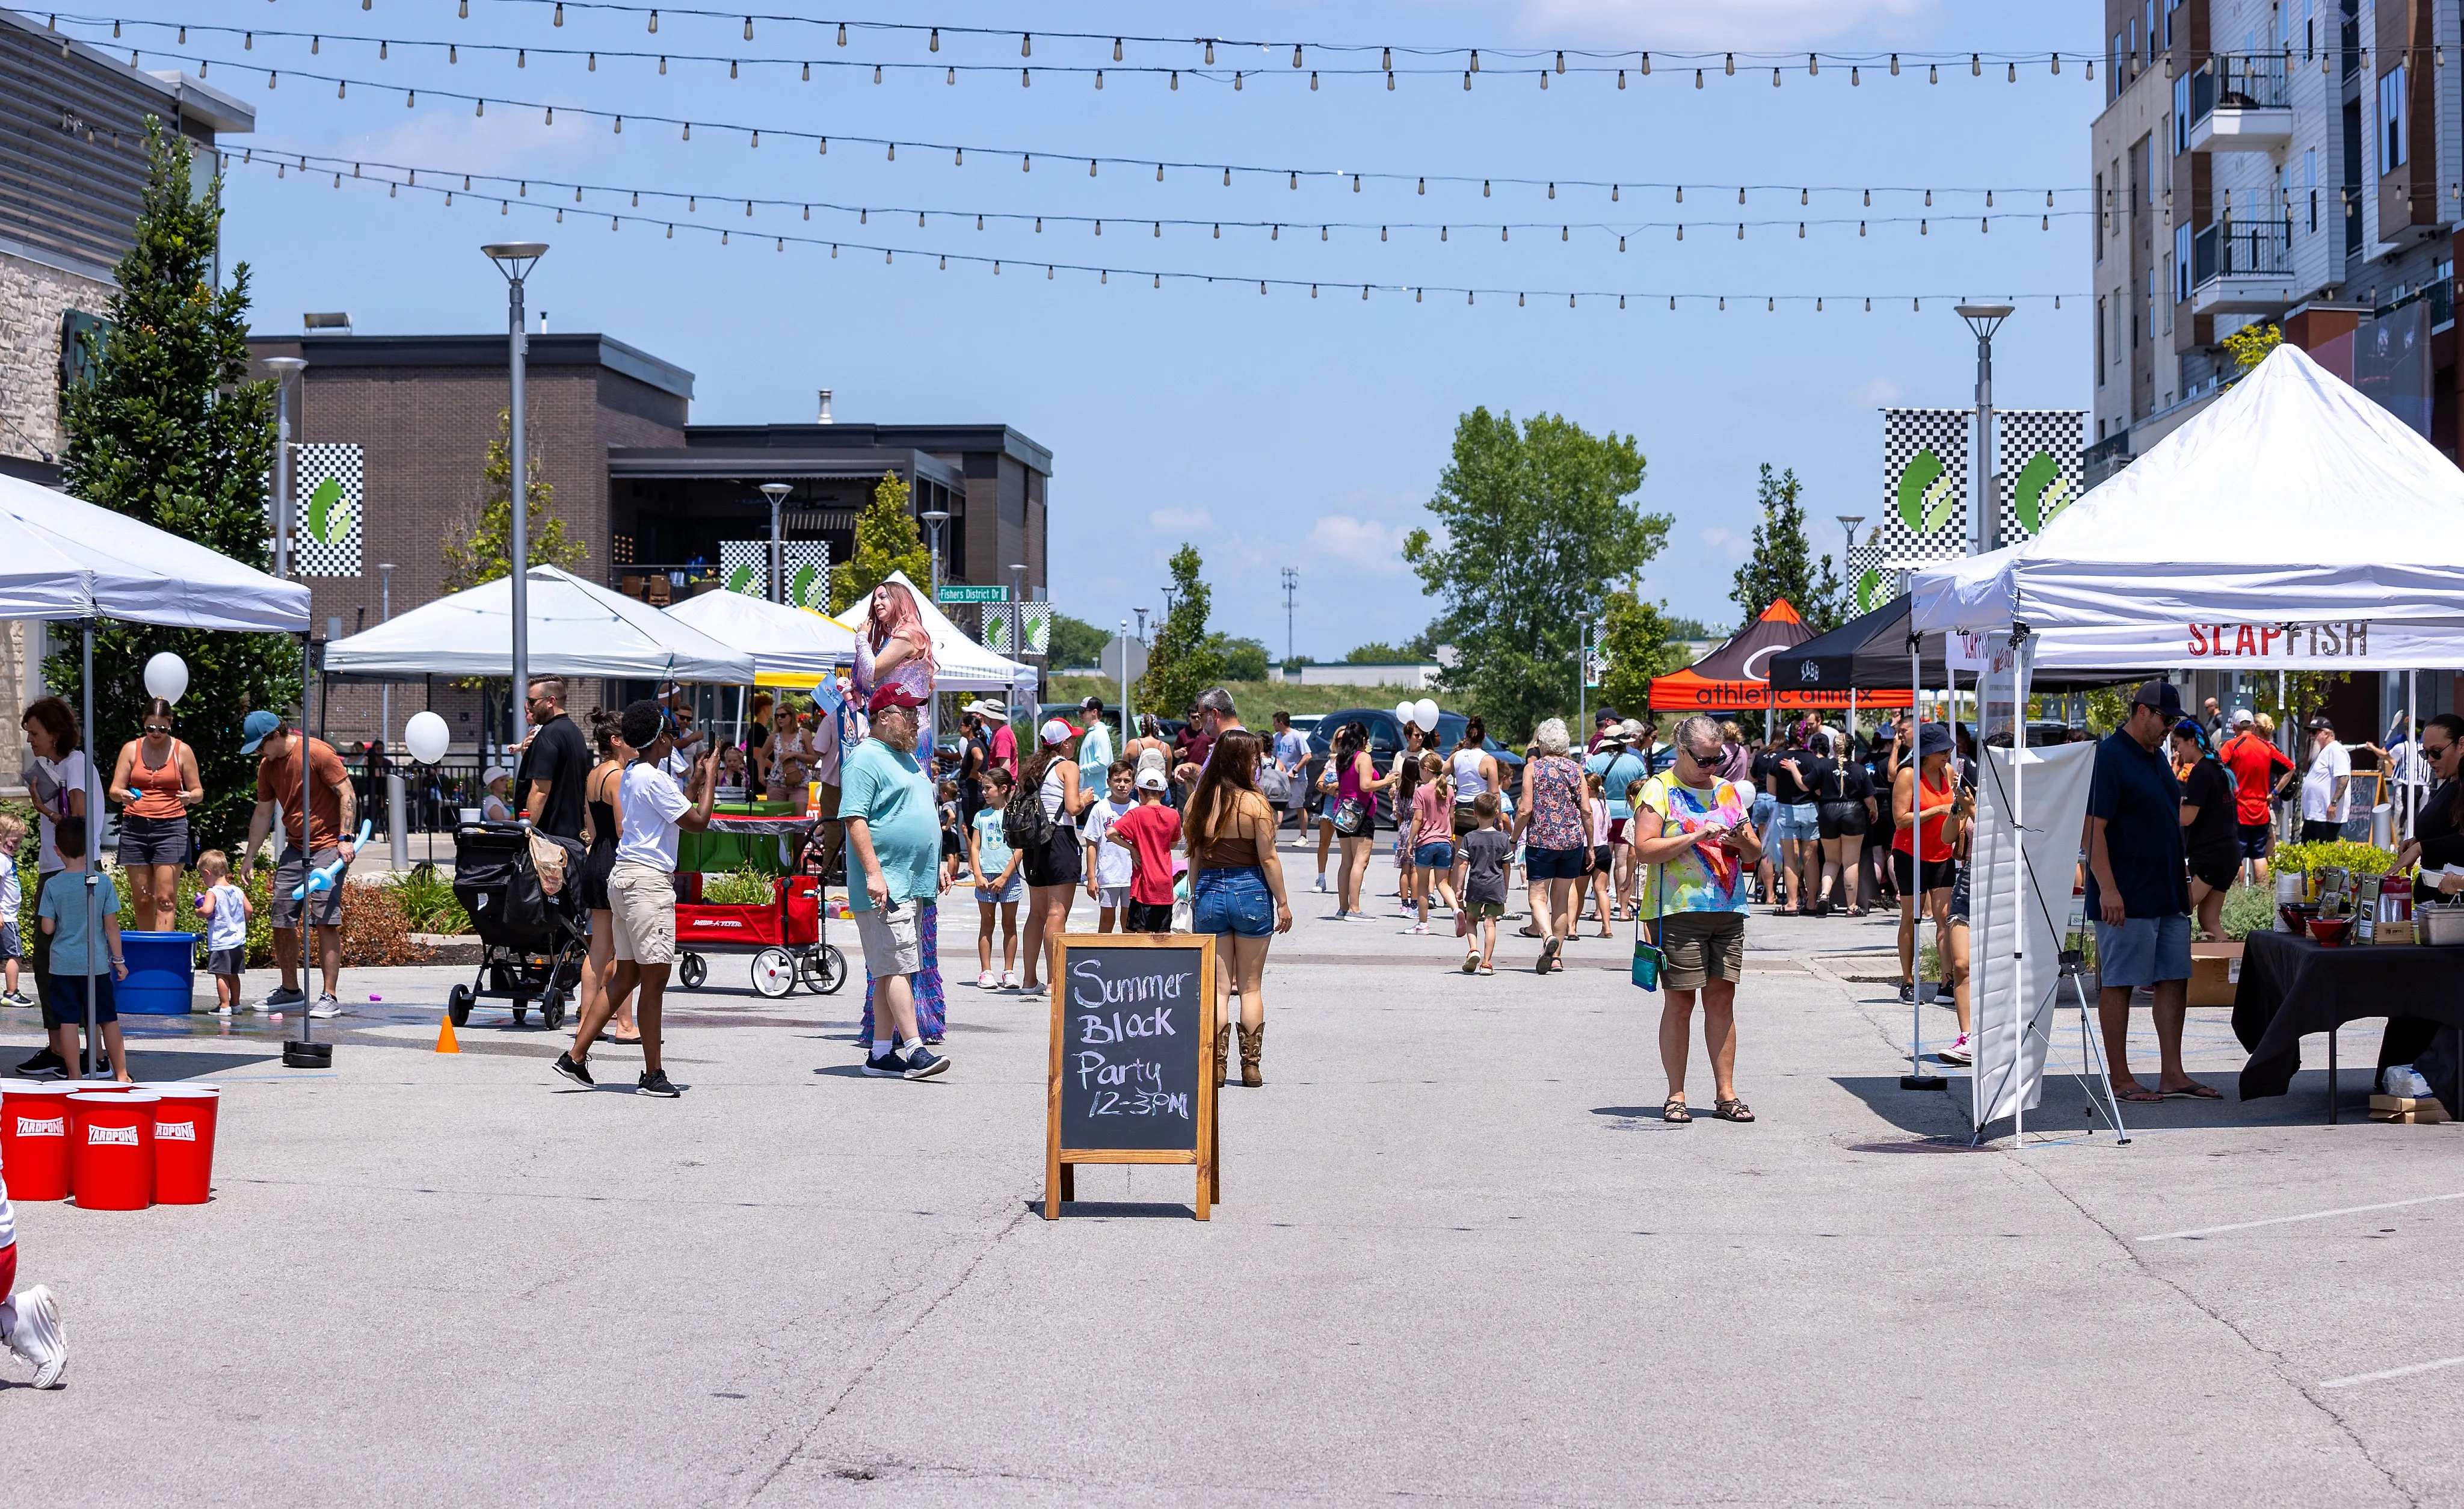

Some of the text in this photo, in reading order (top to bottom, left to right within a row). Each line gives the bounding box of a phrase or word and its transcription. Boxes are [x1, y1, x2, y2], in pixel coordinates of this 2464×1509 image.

[940, 588, 964, 599] Fishers
[966, 588, 990, 599] District
[991, 588, 999, 599] Dr
[2187, 622, 2368, 656] SLAPFISH
[2004, 649, 2031, 668] SLAISH
[836, 667, 852, 678] IGNIT
[1800, 659, 1819, 681] KKBB
[1696, 682, 1873, 705] athletic annex
[1073, 958, 1194, 1009] Summer
[1077, 1007, 1177, 1045] Block
[1071, 1051, 1162, 1097] Party
[1088, 1091, 1189, 1120] 12-3PM
[17, 1119, 64, 1134] YARDPONG
[88, 1127, 138, 1143] YARDPONG
[155, 1123, 196, 1138] RDPONG
